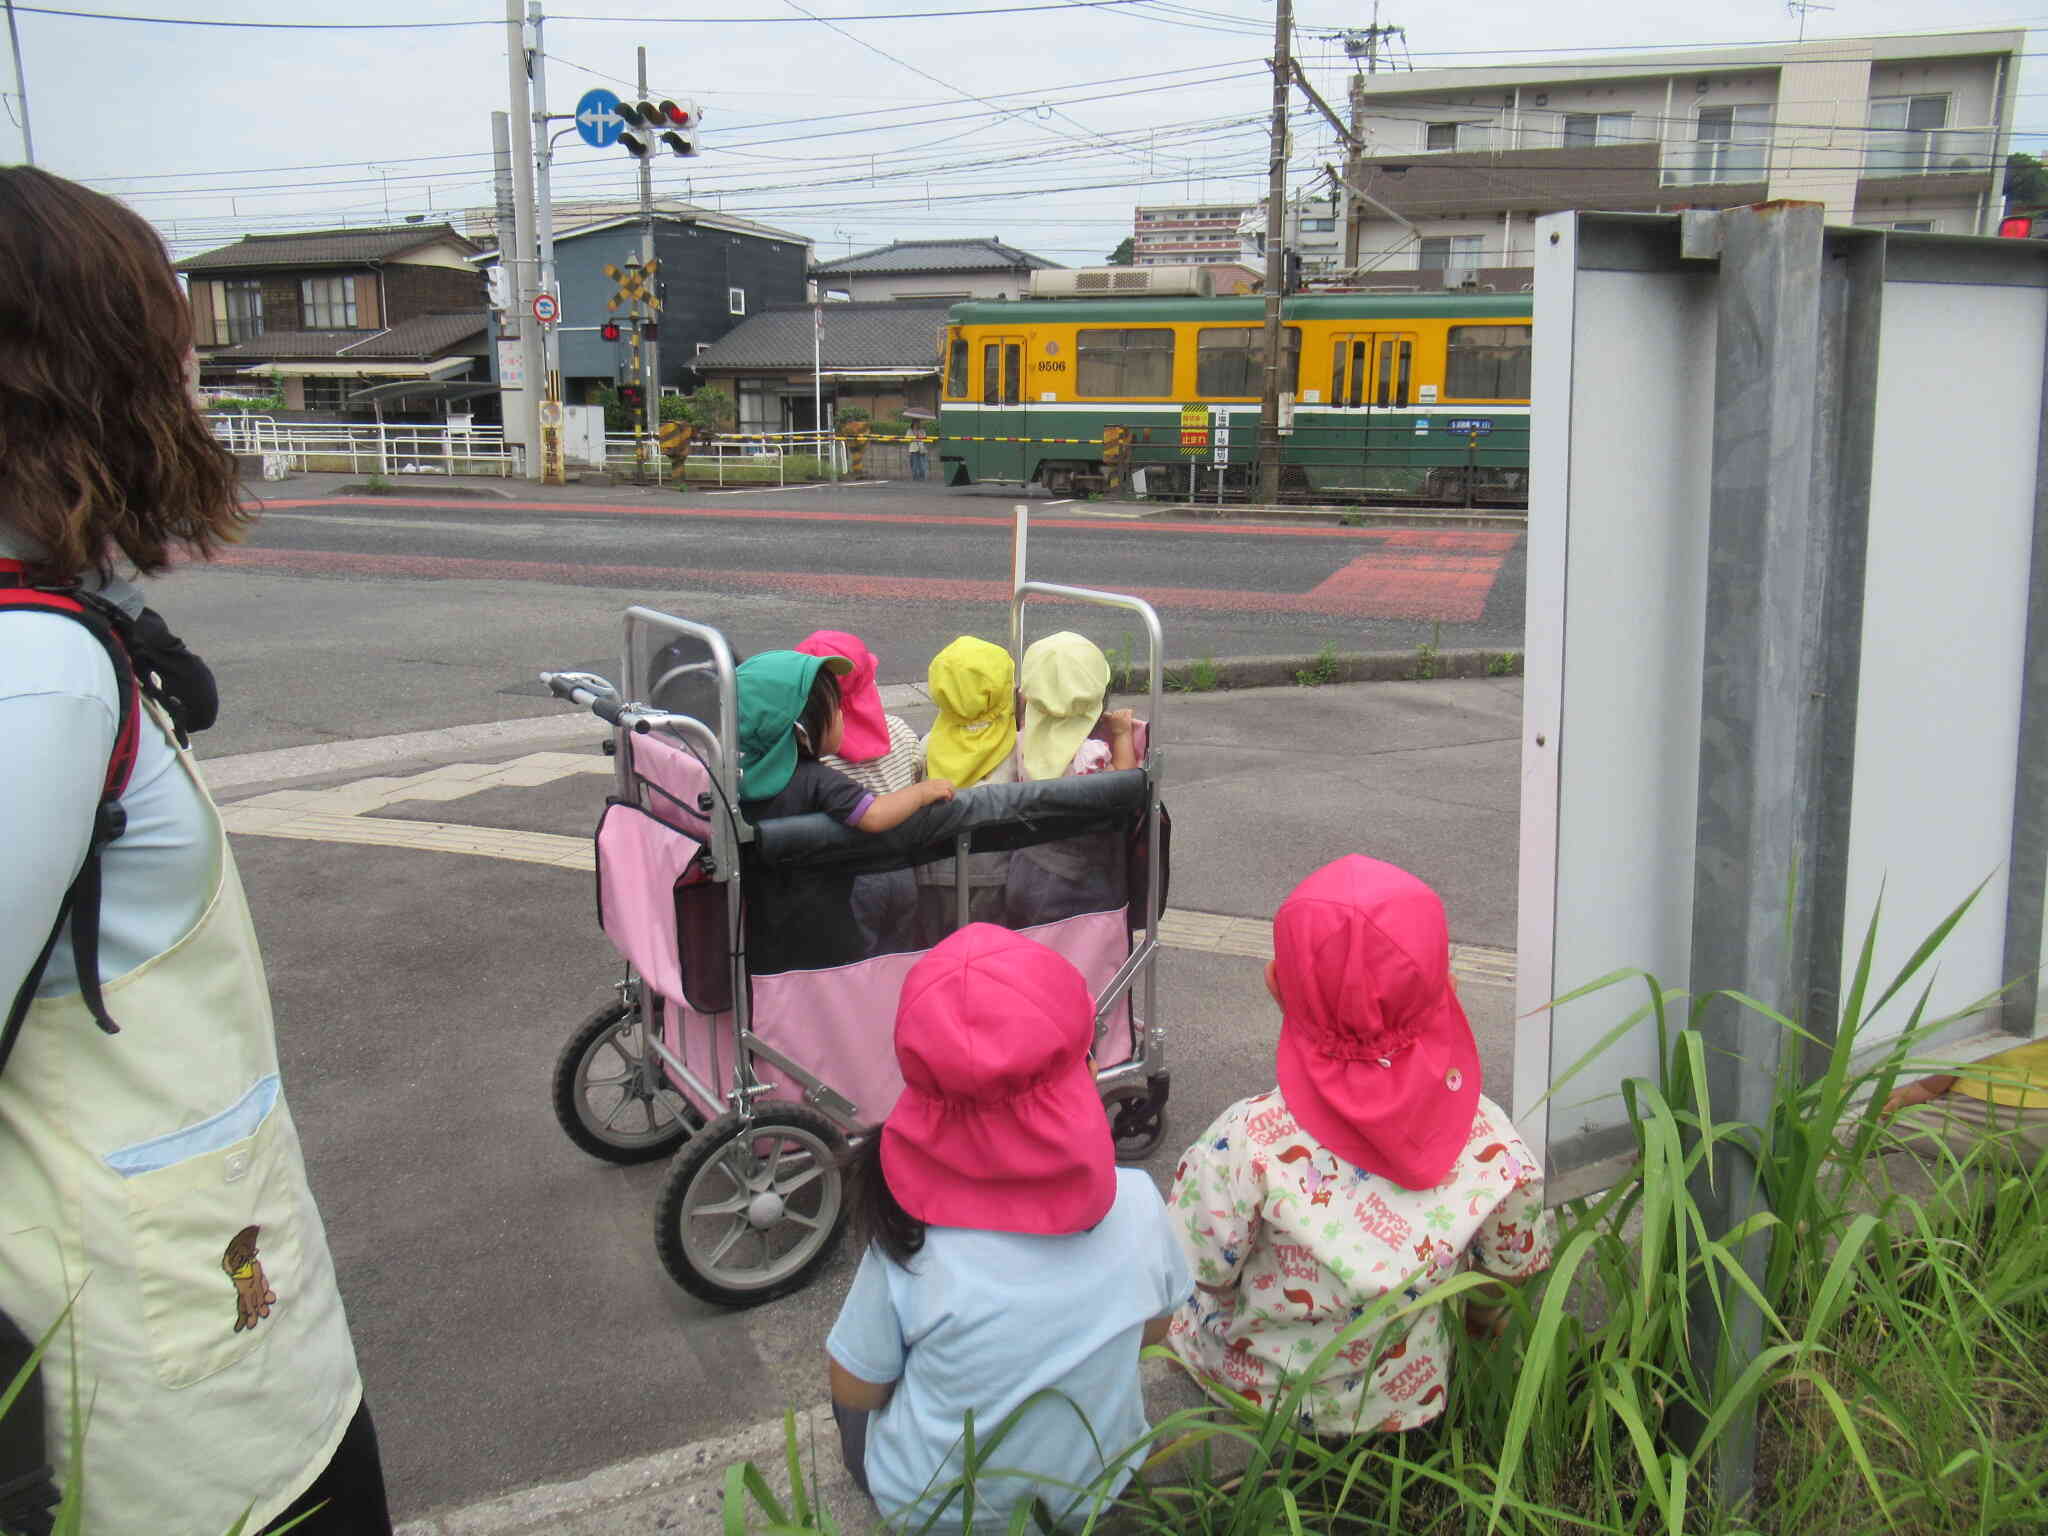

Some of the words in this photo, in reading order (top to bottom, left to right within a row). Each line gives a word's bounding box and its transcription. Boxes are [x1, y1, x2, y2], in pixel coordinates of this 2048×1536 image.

[1038, 360, 1066, 372] 9506
[1353, 1202, 1409, 1253] WILDE
[1380, 1355, 1433, 1396] WILDE
